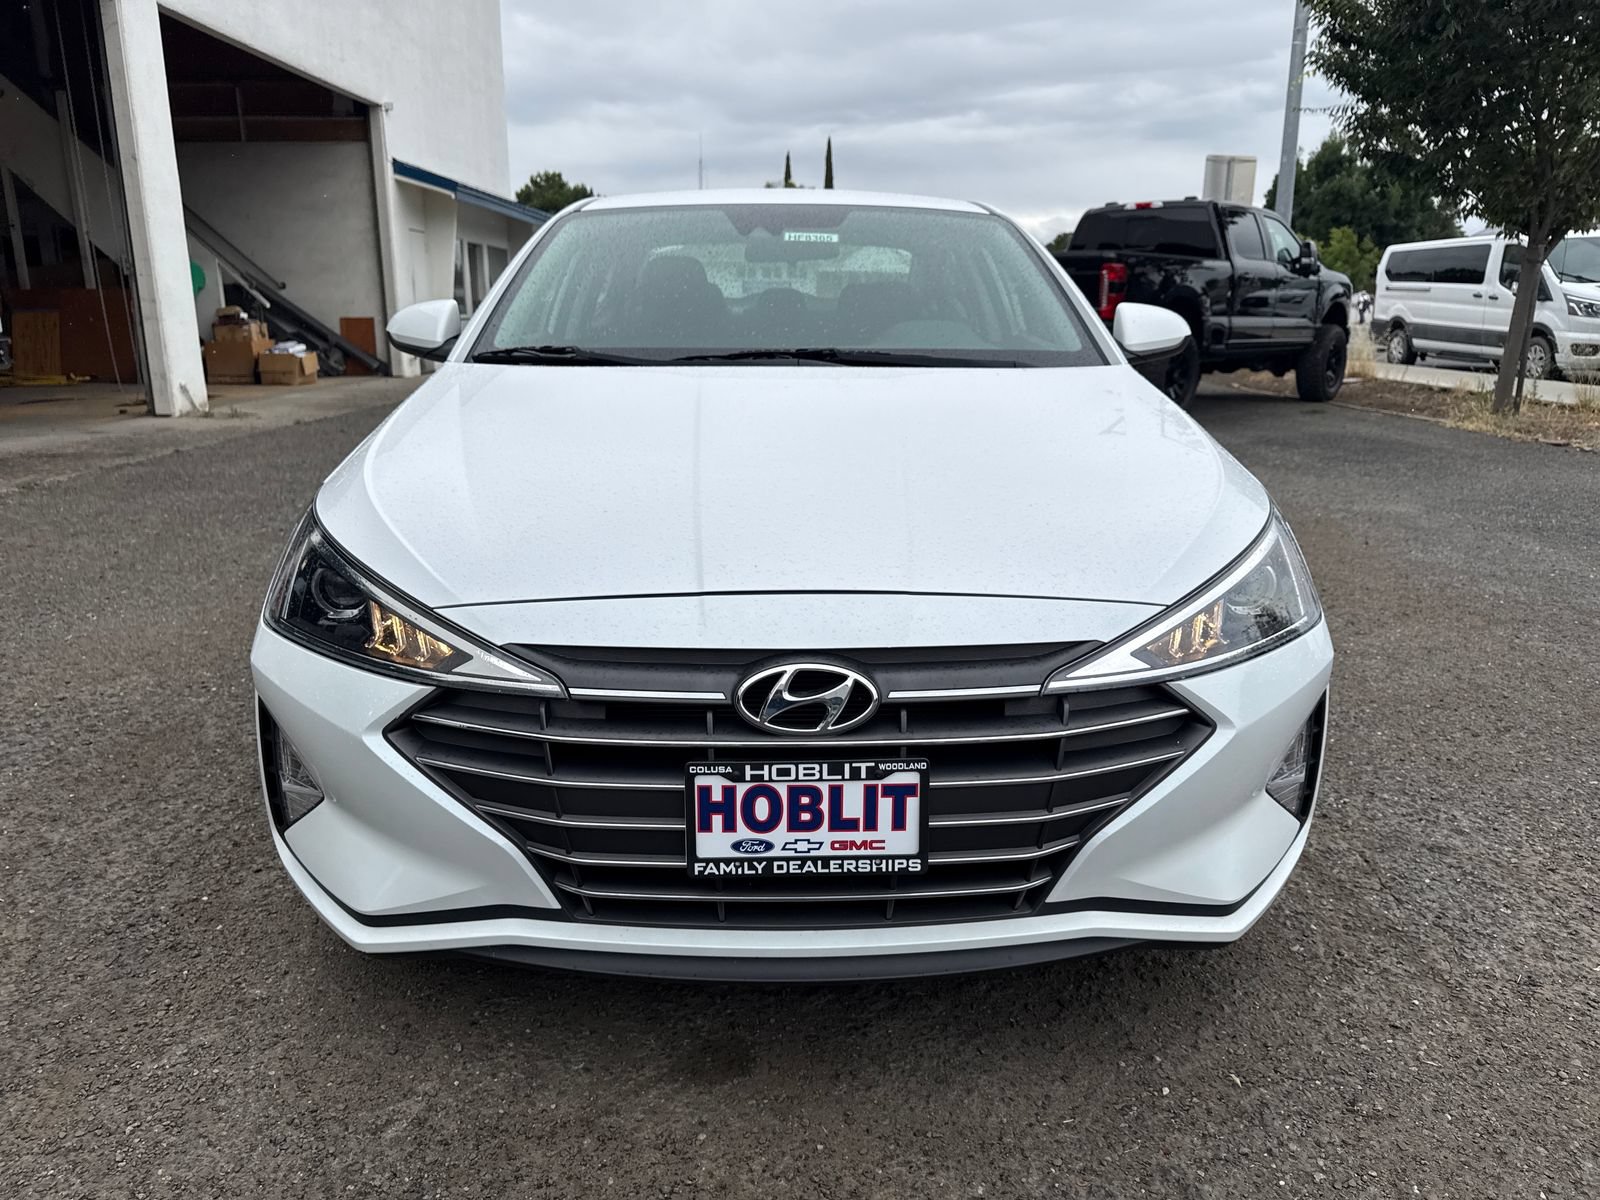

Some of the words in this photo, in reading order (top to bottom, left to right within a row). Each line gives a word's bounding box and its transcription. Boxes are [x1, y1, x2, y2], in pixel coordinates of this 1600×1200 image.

[689, 766, 733, 774] COLUSA
[745, 762, 875, 781] HOBLIT
[878, 762, 927, 771] WOODLAND
[697, 783, 919, 834] HOBLIT
[830, 840, 886, 851] GMC
[694, 860, 767, 875] FAMILY
[773, 858, 922, 874] DEALERSHIPS
